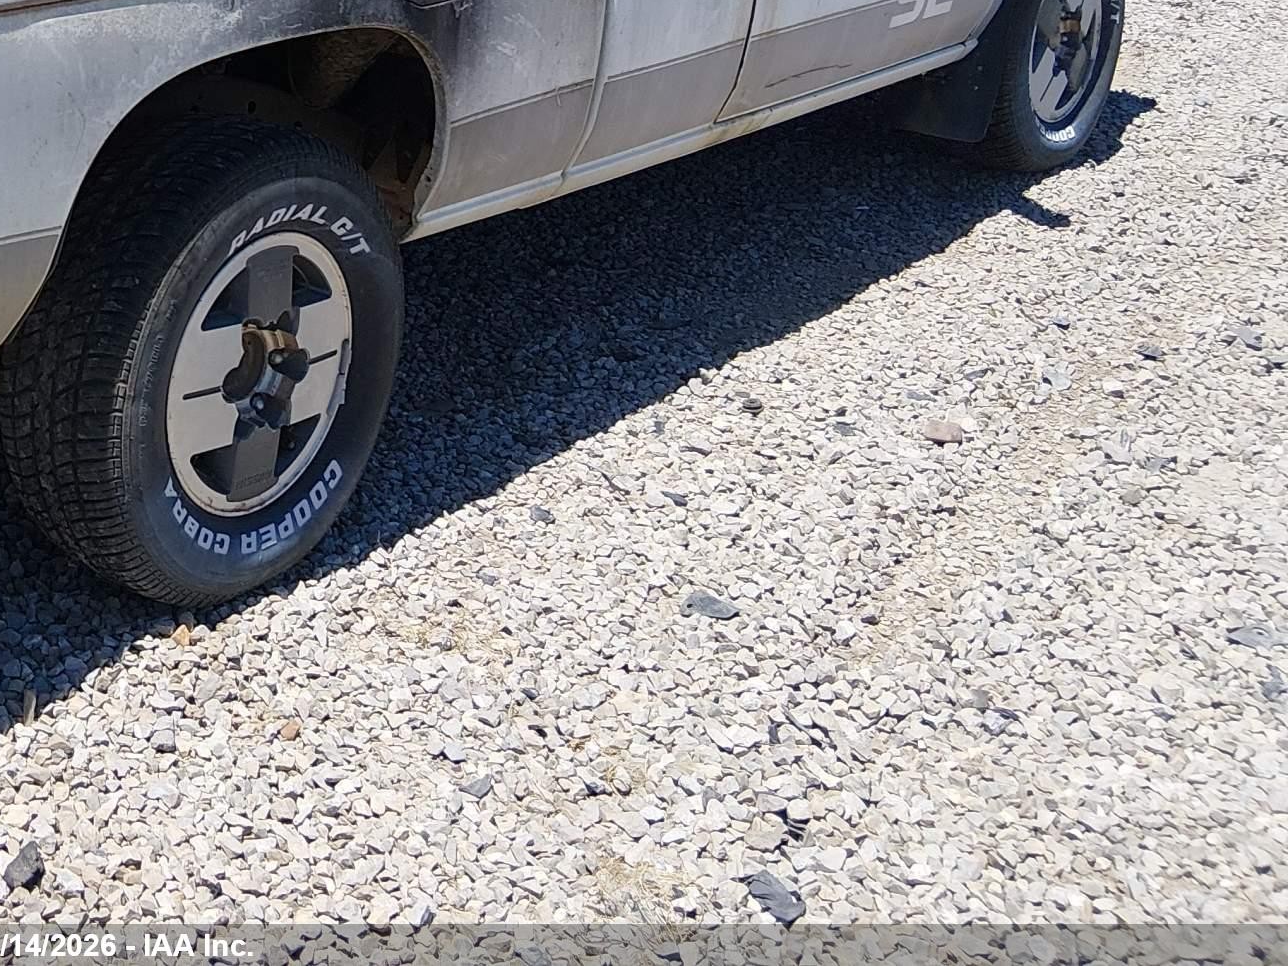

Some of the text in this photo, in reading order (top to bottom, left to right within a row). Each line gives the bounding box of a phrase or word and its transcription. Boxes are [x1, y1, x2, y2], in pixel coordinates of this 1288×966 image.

[228, 203, 372, 257] RADIAL G/T
[164, 459, 344, 556] COOPER COBRA
